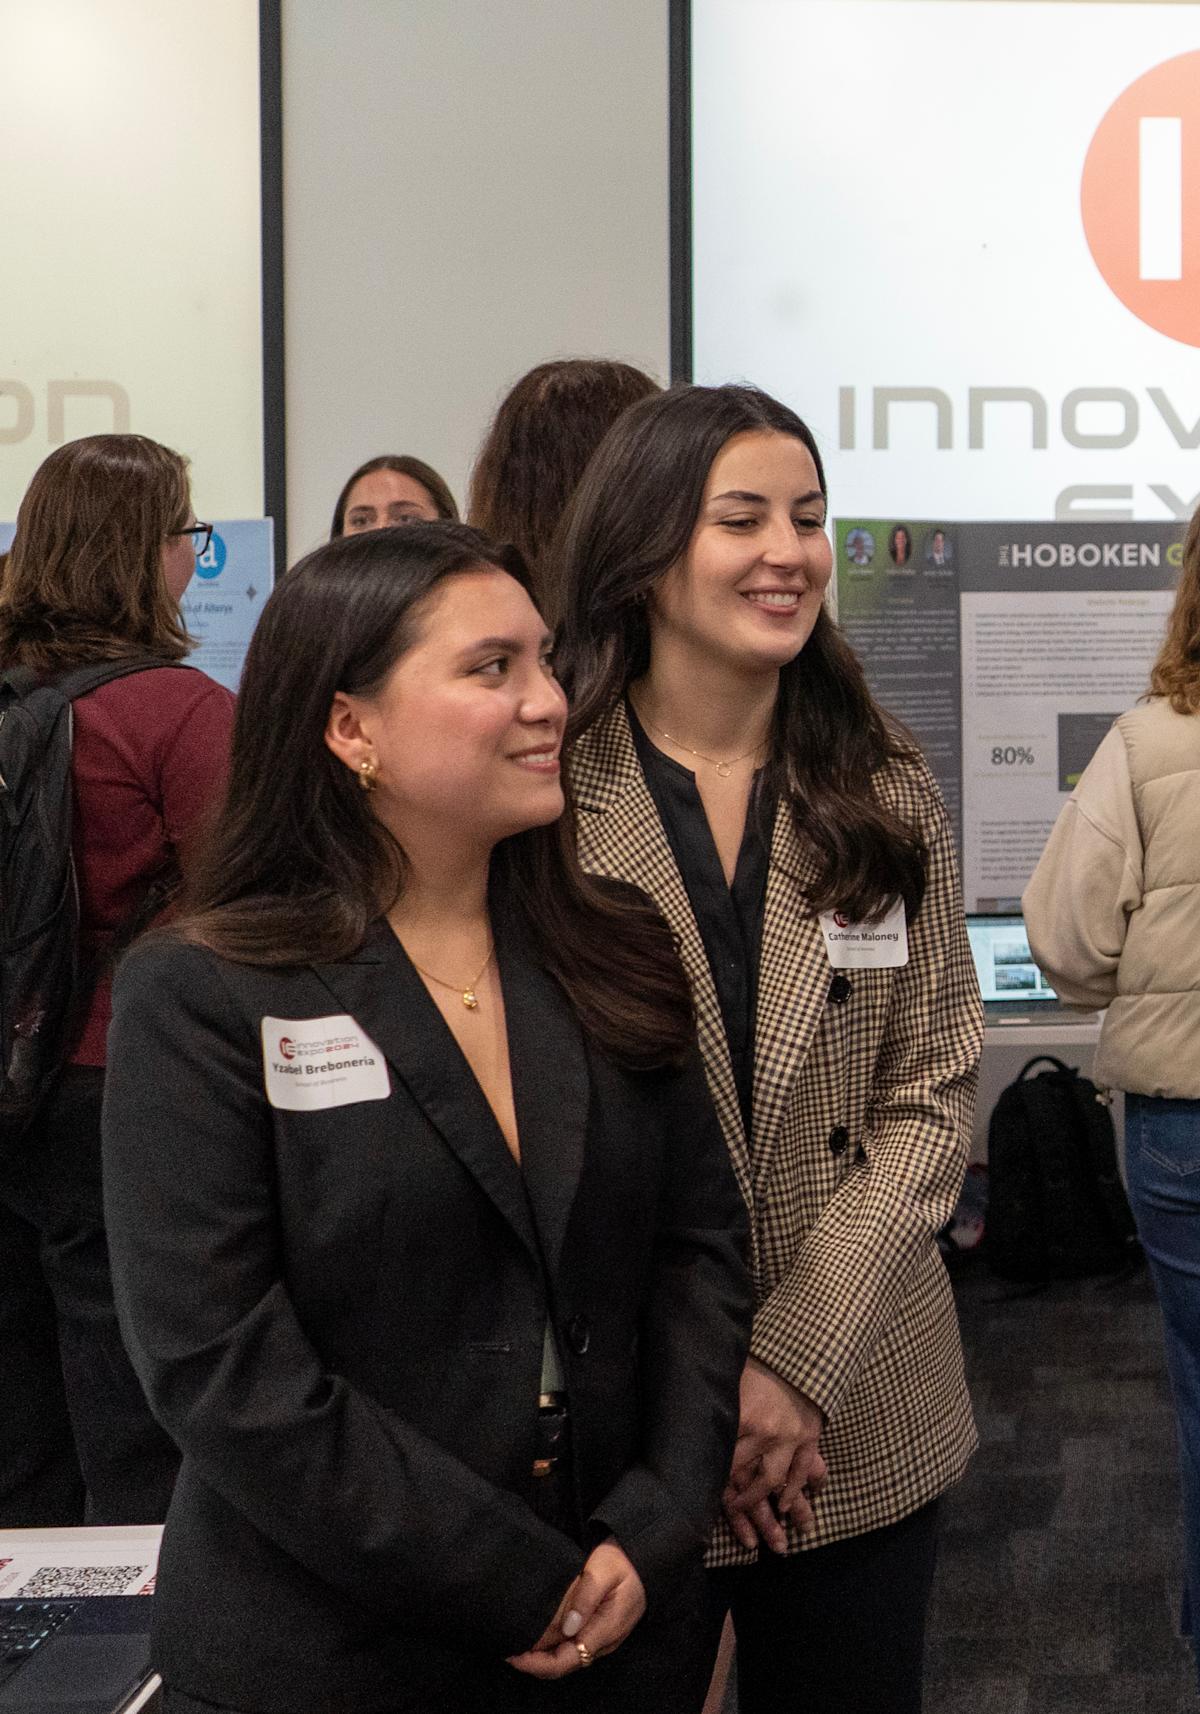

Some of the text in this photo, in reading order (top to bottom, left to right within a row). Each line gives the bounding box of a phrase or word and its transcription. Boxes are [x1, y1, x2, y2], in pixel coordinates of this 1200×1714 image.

[1011, 543, 1160, 567] HOBOKEN
[991, 746, 1035, 765] 80%
[861, 931, 899, 942] Maloney
[272, 1063, 303, 1075] Yzabel
